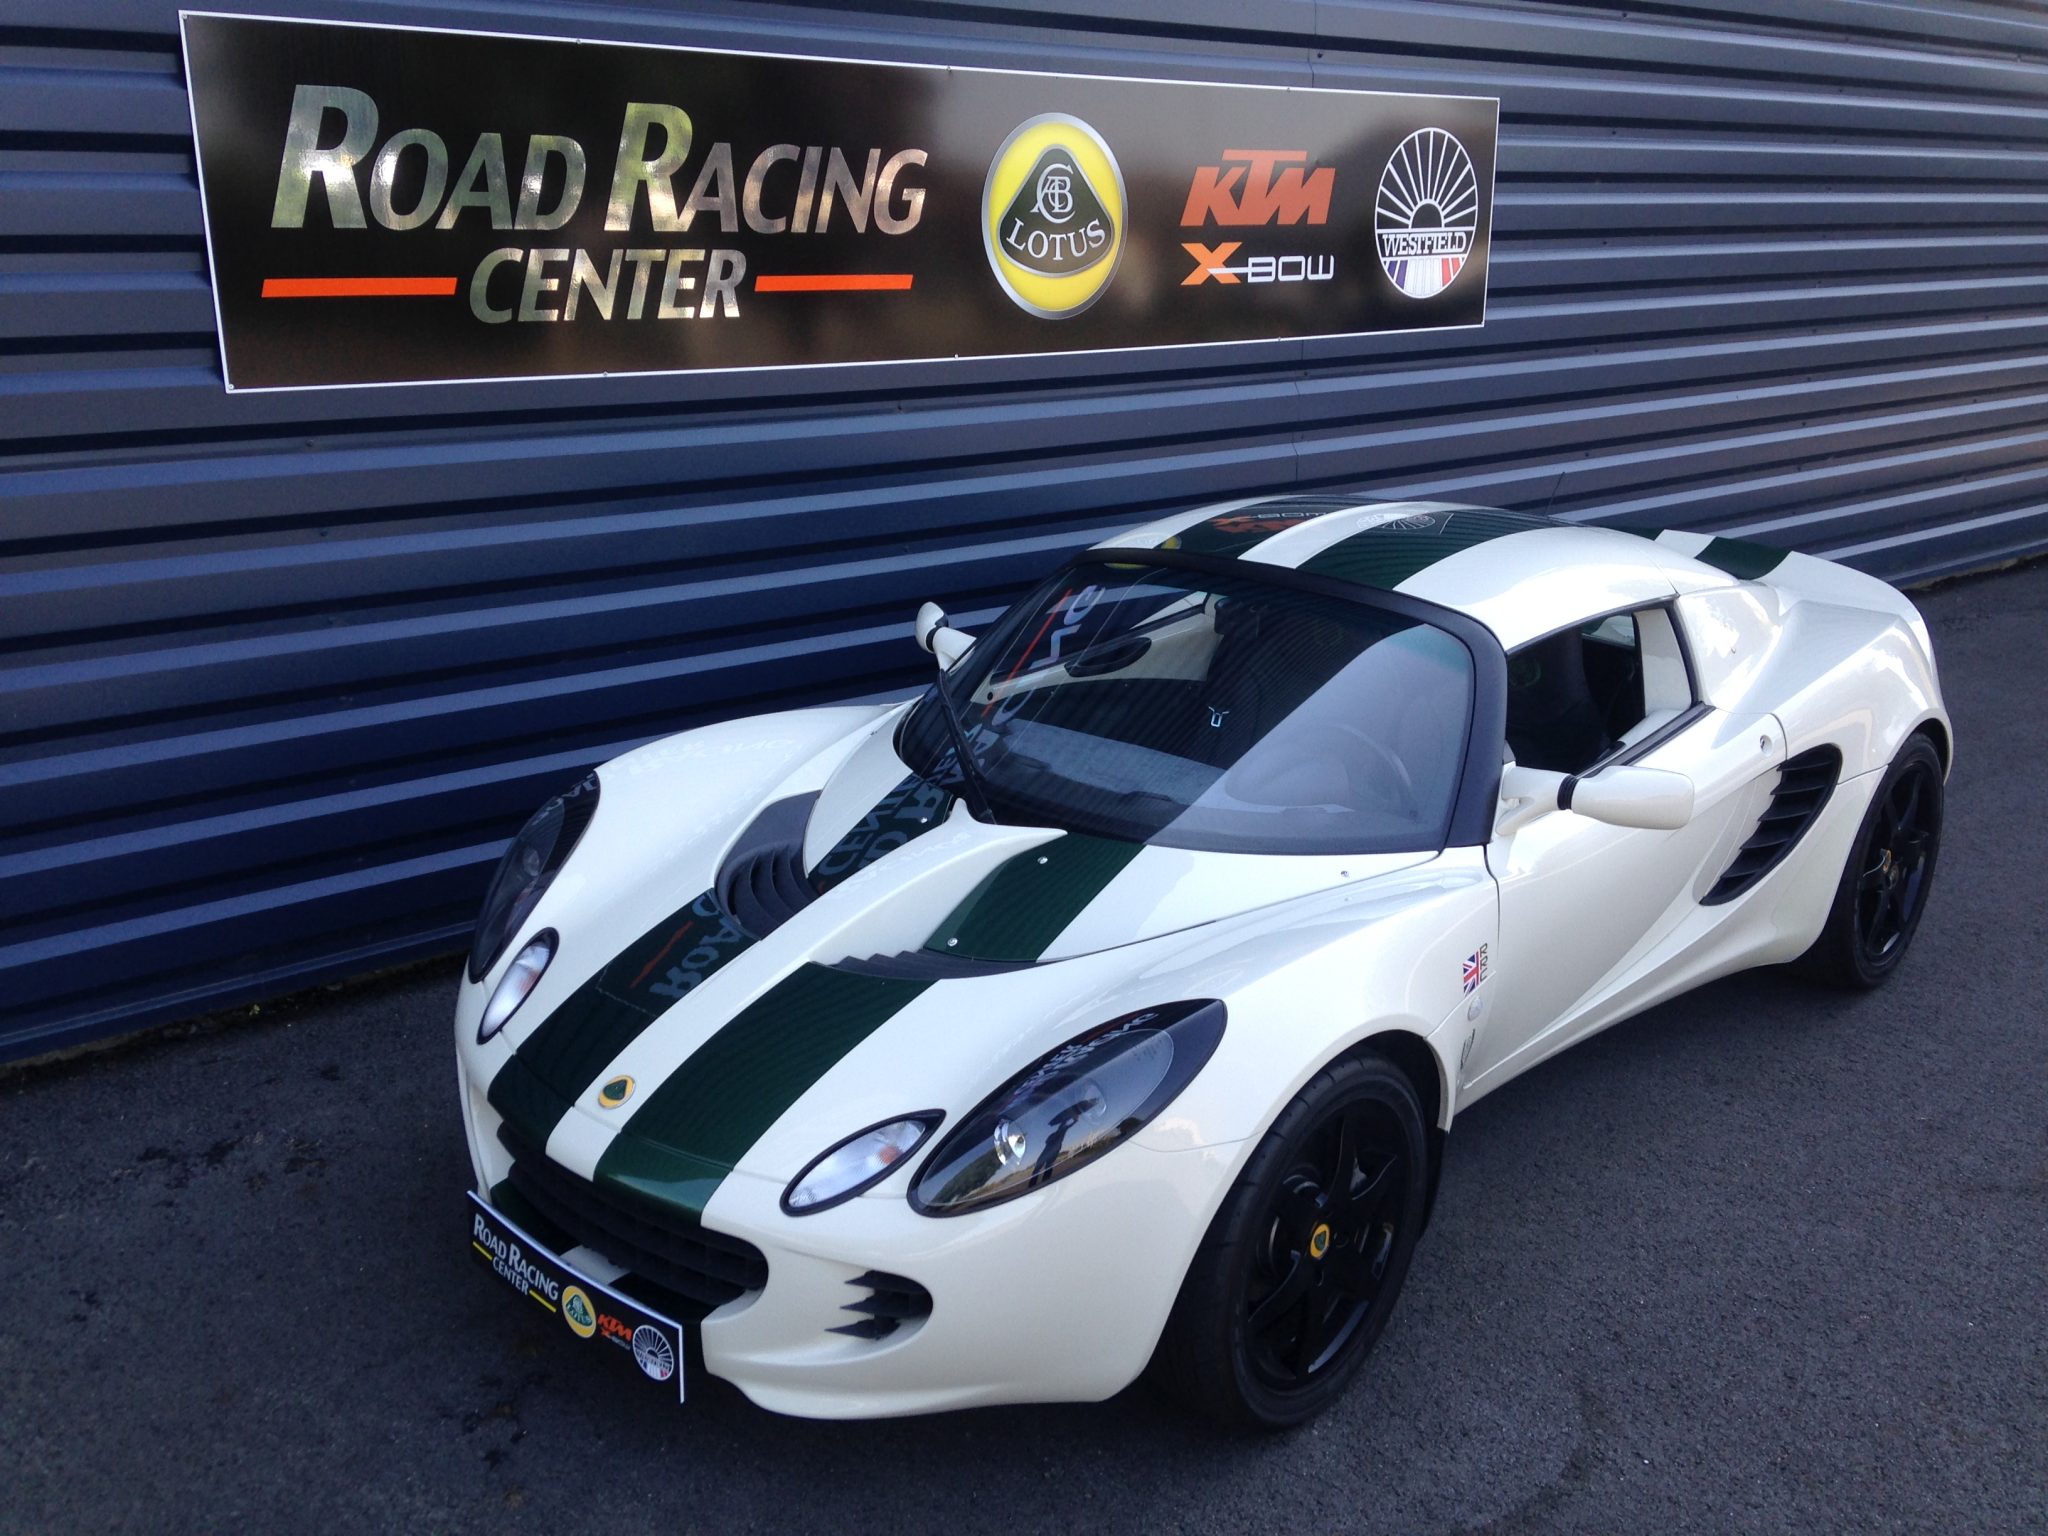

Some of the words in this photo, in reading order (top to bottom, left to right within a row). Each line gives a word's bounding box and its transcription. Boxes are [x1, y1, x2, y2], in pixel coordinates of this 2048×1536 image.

[270, 84, 586, 232] ROAD
[603, 102, 928, 235] RACING
[1180, 149, 1336, 226] KTM
[1006, 217, 1106, 261] LOTUS
[1382, 231, 1467, 257] WESTFIELD
[469, 248, 747, 324] CENTER
[474, 1212, 507, 1260] ROAD
[508, 1242, 558, 1301] RACING
[492, 1256, 529, 1295] CENTER
